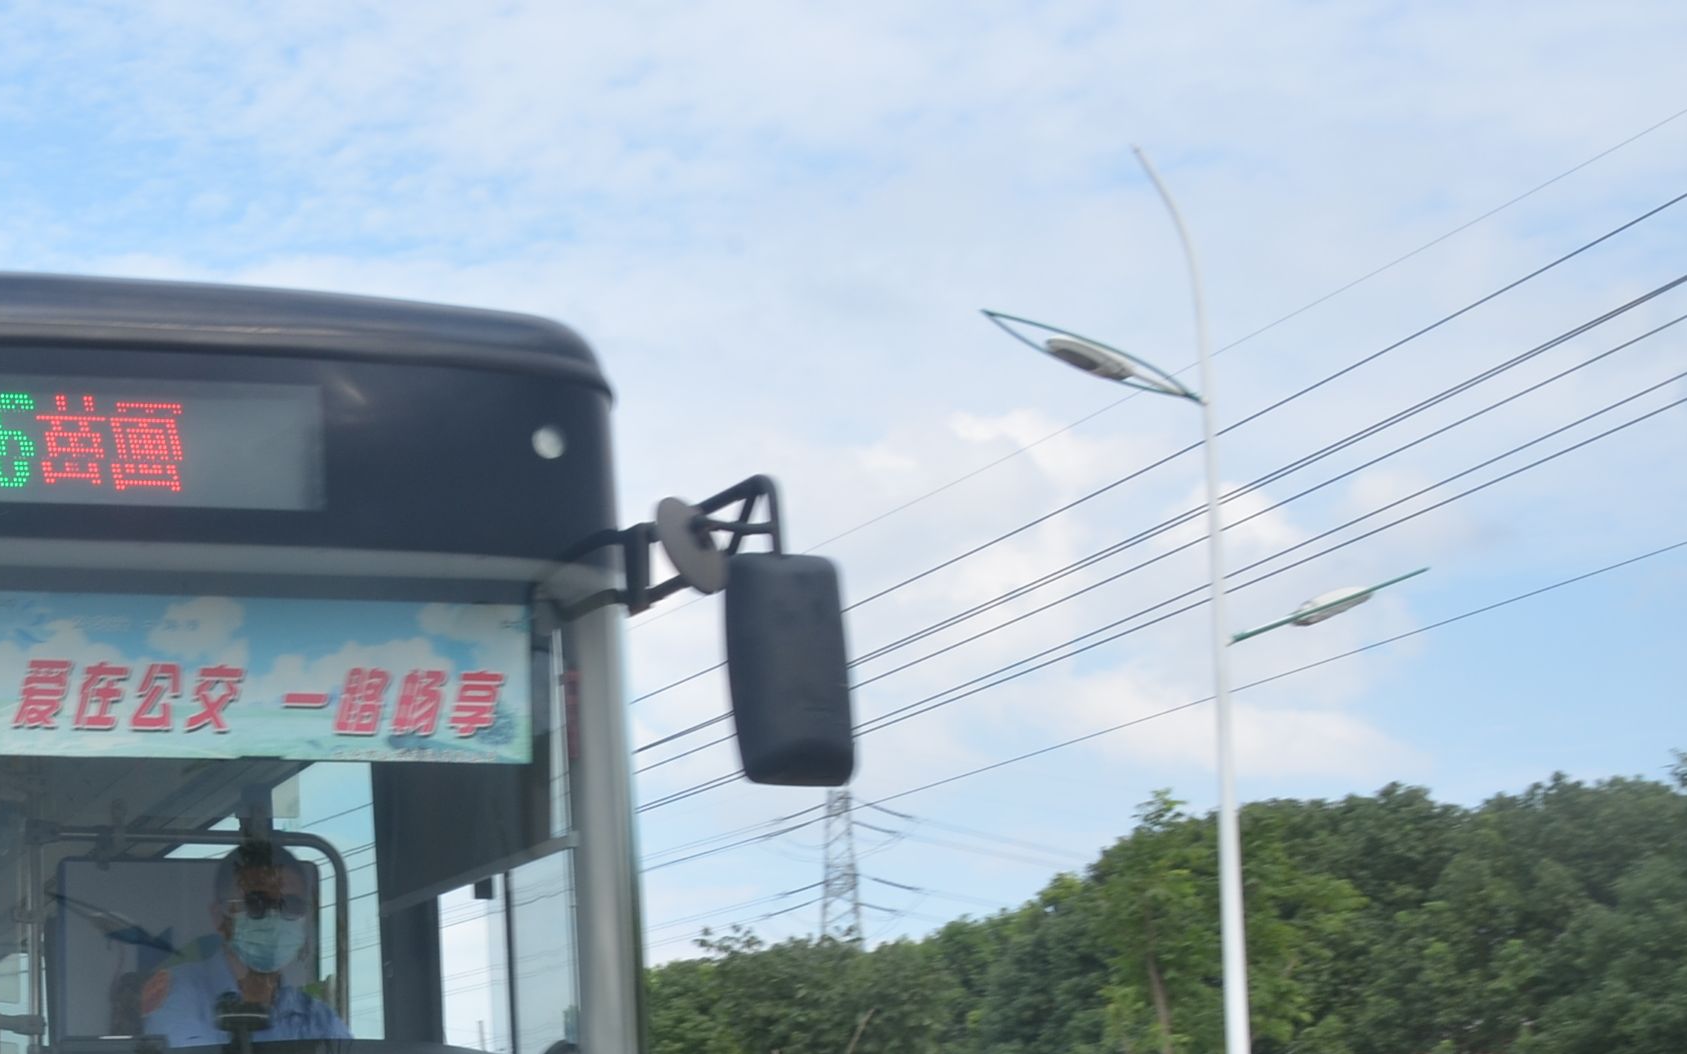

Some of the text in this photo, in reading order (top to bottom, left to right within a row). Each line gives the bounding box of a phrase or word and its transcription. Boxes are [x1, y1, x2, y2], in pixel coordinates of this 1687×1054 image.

[12, 658, 506, 737] 爱在公交 一路畅享
